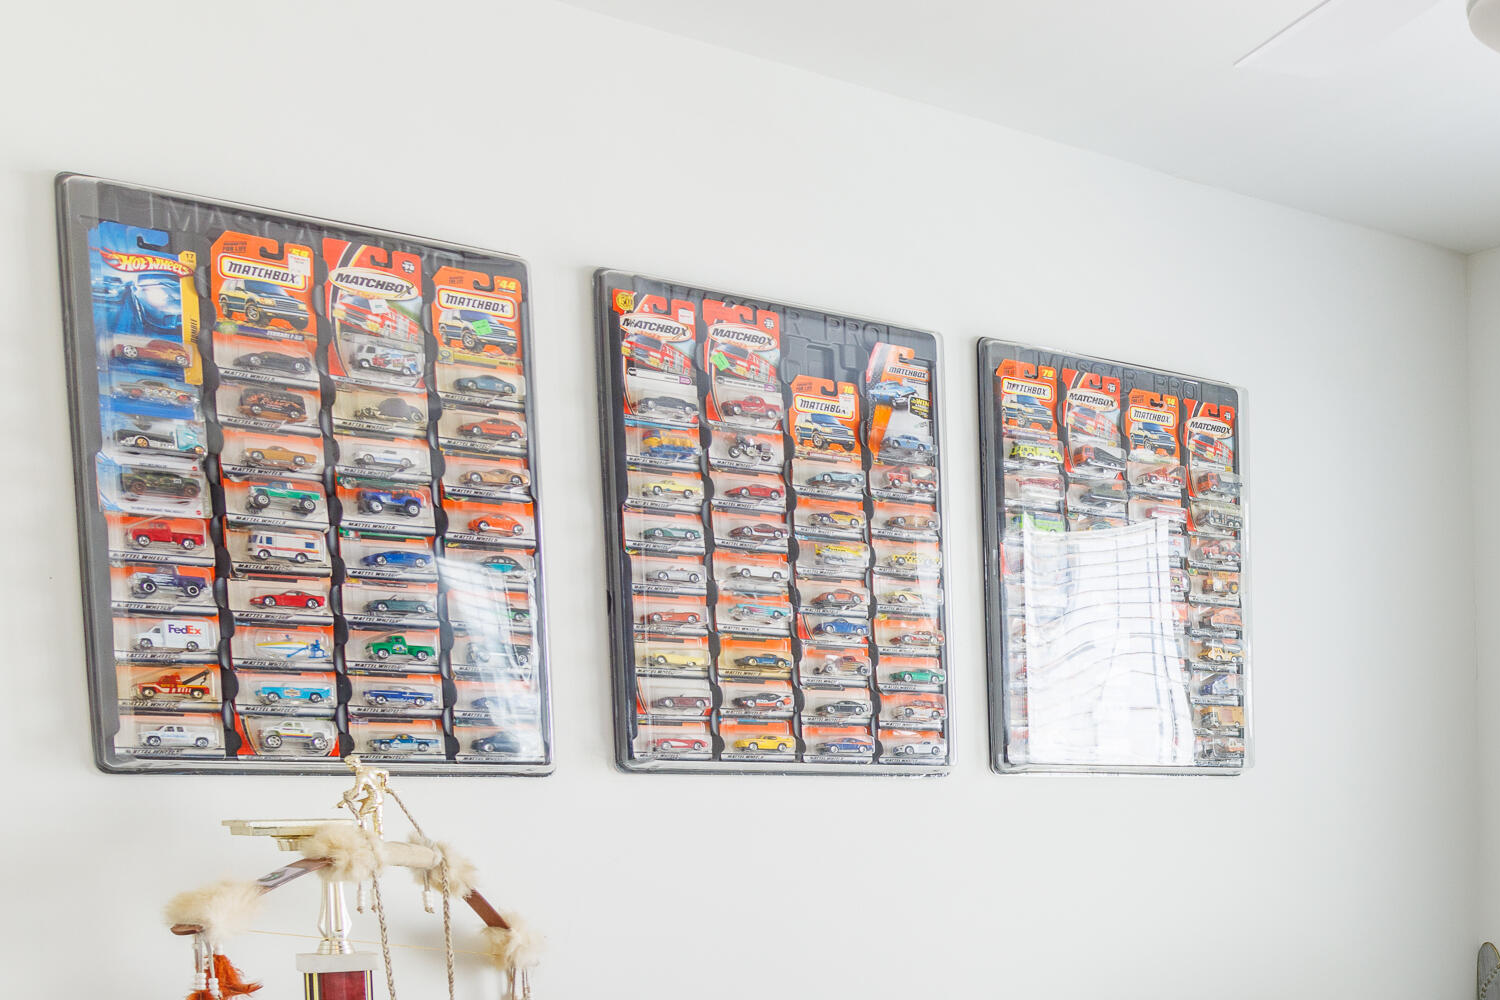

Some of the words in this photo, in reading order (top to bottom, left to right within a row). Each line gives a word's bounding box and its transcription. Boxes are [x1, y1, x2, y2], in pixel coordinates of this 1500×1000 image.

[228, 261, 297, 284] MATCHBOX
[335, 273, 413, 296] MATCHBOX
[445, 293, 506, 313] MATCHBOX
[622, 318, 688, 338] MATCHBOX
[712, 328, 774, 346] MATCHBOX
[888, 366, 927, 379] MATCHBOX
[800, 398, 846, 415] MATCHBO
[1069, 392, 1116, 408] MATCHBOX
[1134, 409, 1170, 424] MATCHBOX
[1190, 421, 1231, 435] MATCHBOX
[168, 623, 202, 635] FedEx
